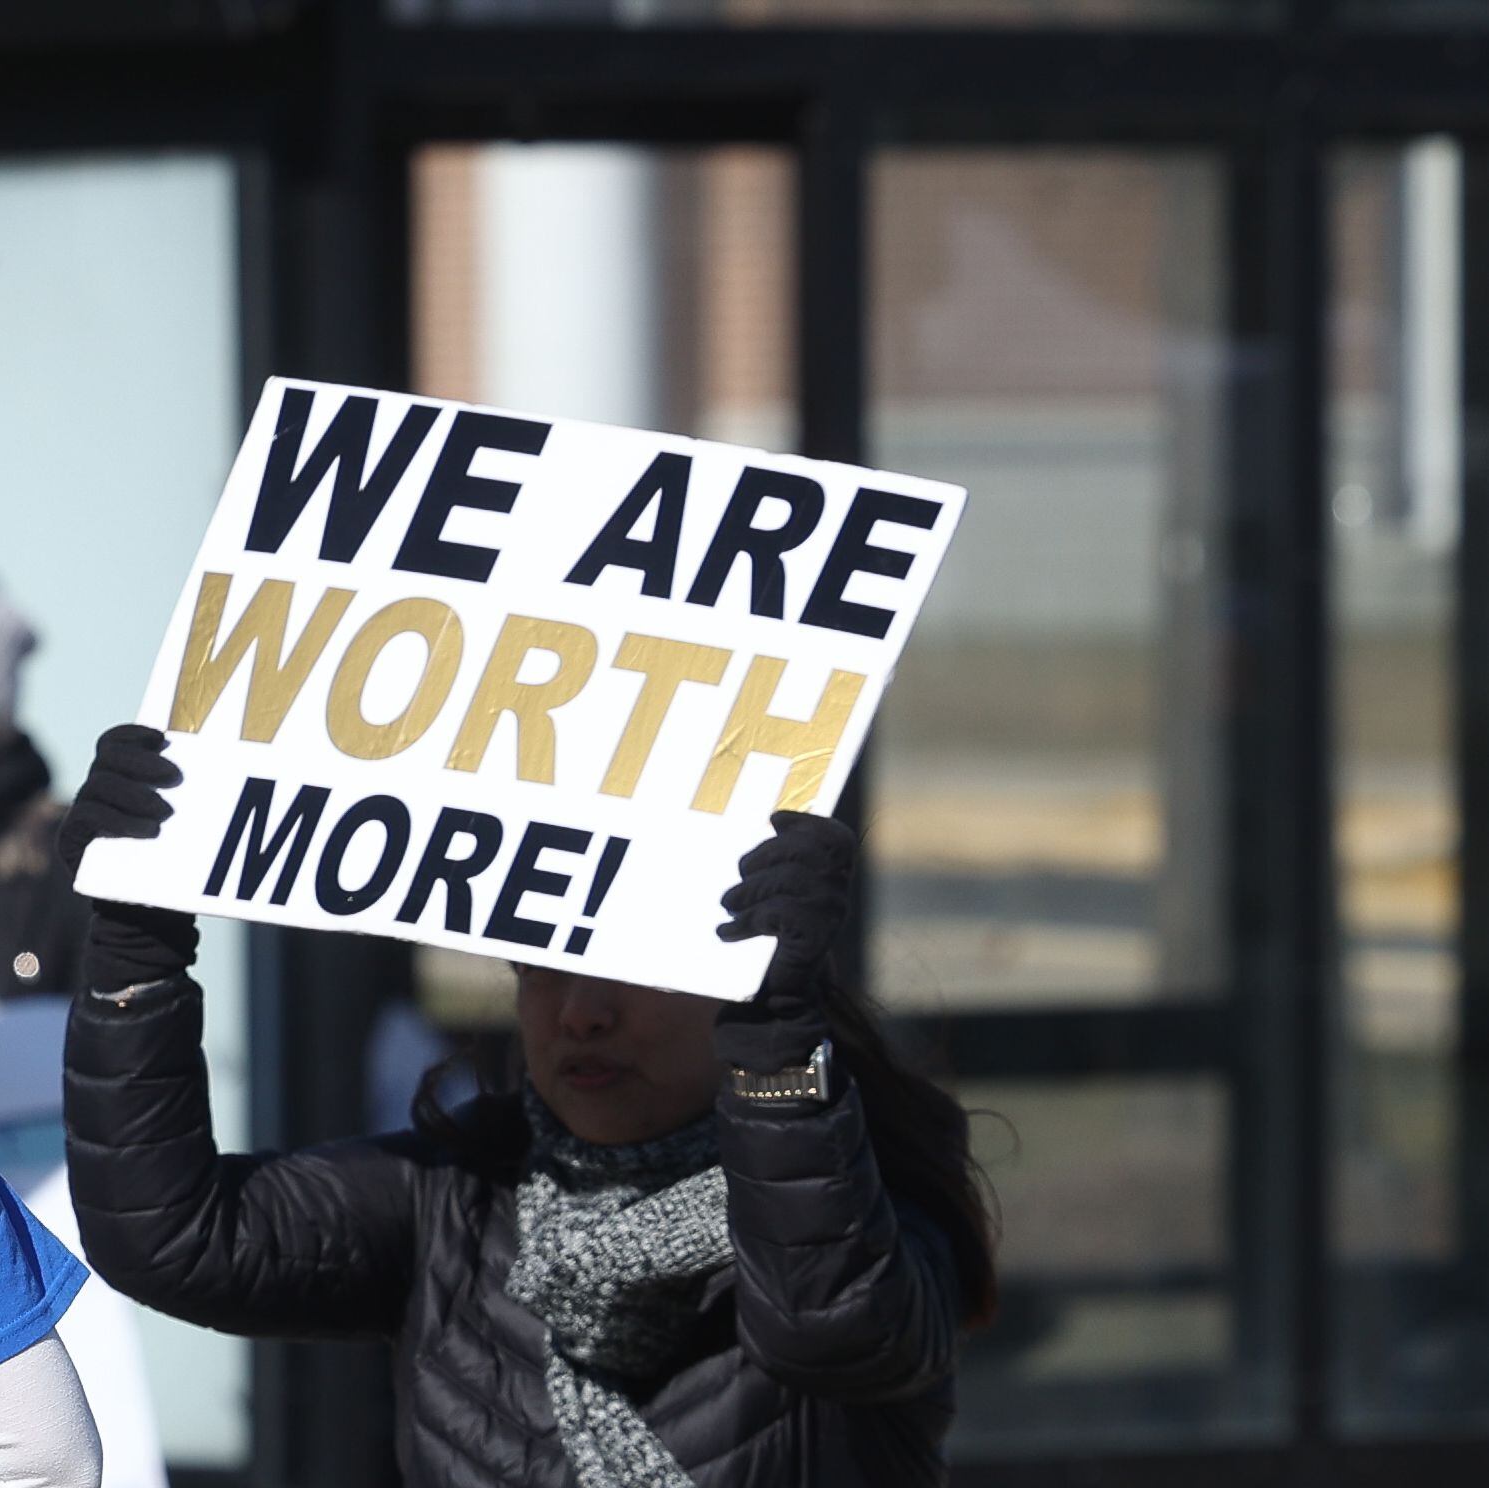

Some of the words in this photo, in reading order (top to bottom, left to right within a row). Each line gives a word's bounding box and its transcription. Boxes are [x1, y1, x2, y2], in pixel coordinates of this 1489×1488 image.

[244, 388, 554, 584] WE
[563, 451, 944, 640] ARE
[167, 571, 868, 816] WORTH
[202, 777, 631, 957] MORE!
